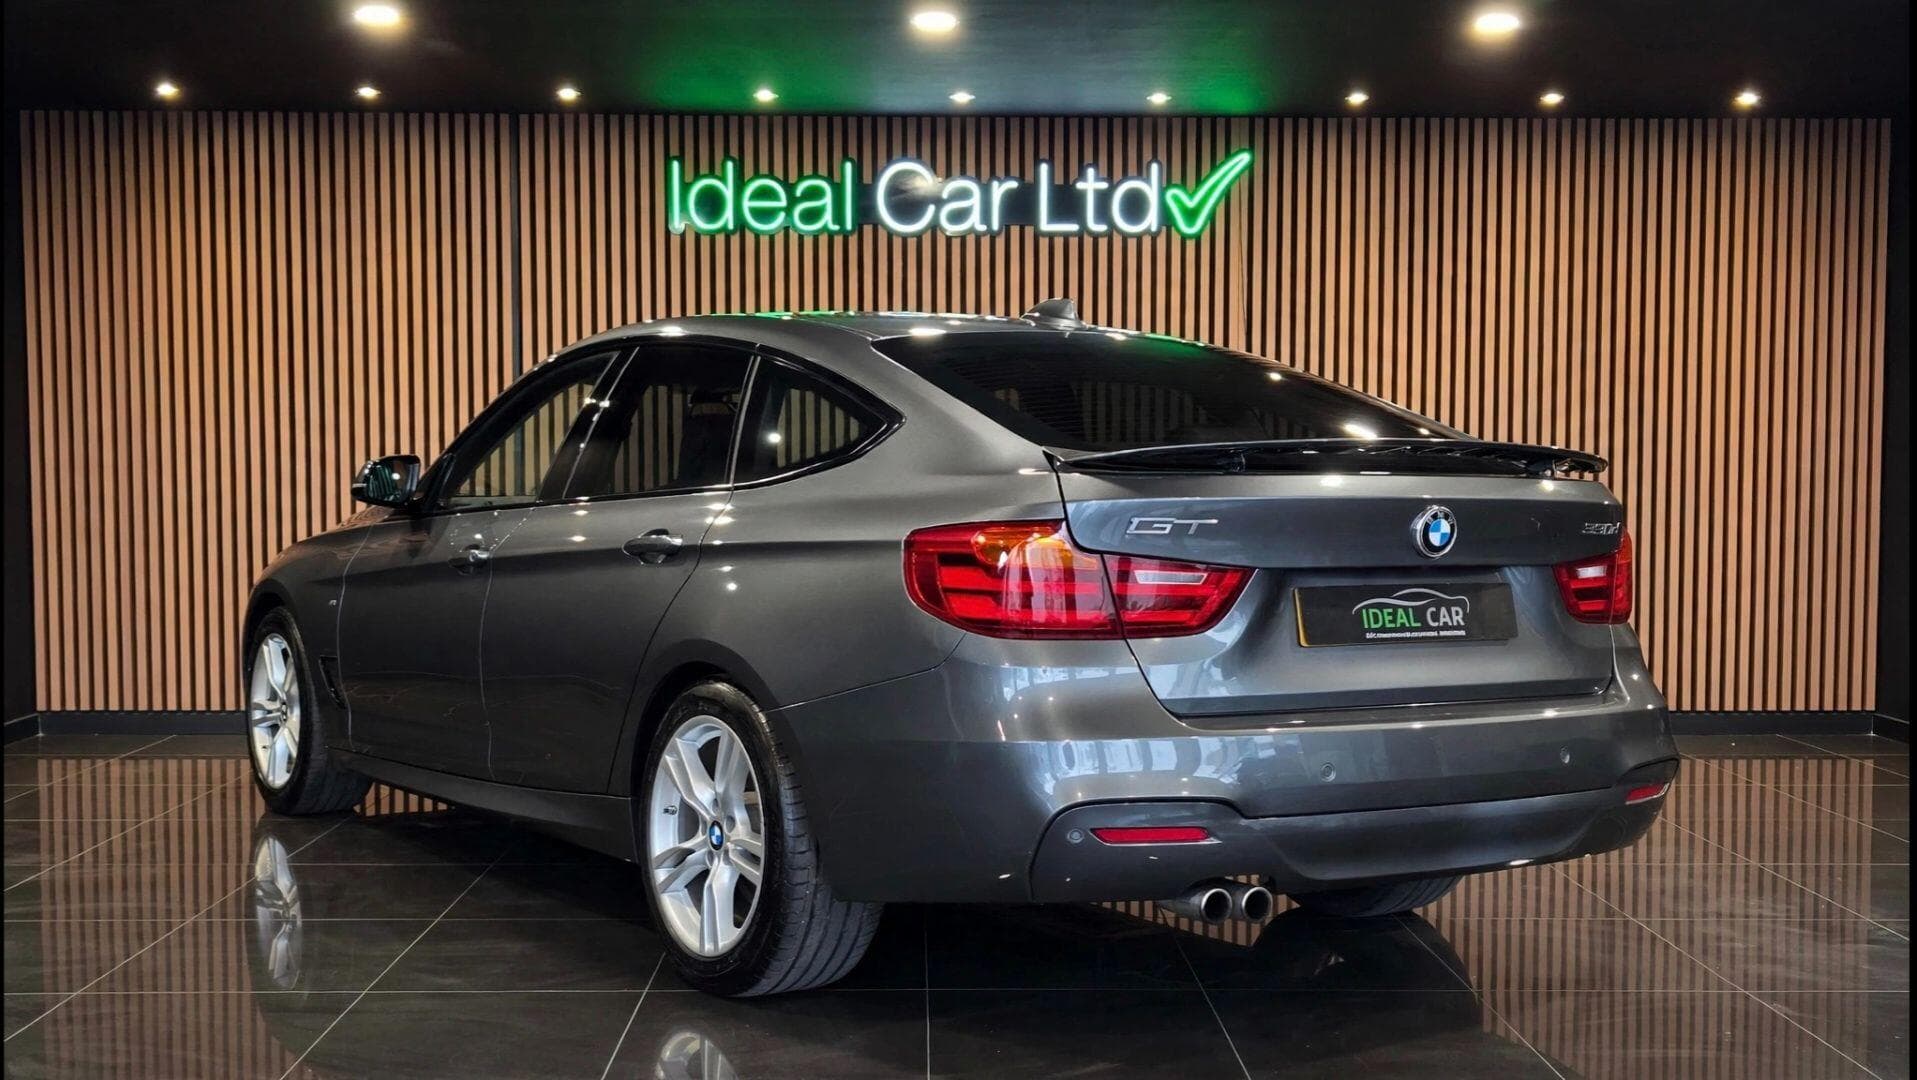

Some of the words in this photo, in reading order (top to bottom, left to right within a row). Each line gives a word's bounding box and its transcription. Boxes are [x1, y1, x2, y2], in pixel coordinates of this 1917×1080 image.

[668, 156, 856, 234] Ideal
[876, 159, 1018, 235] Car
[1037, 159, 1161, 234] Ltd
[1126, 517, 1219, 535] GT
[1361, 607, 1422, 629] IDEAL
[1426, 606, 1466, 627] CAR
